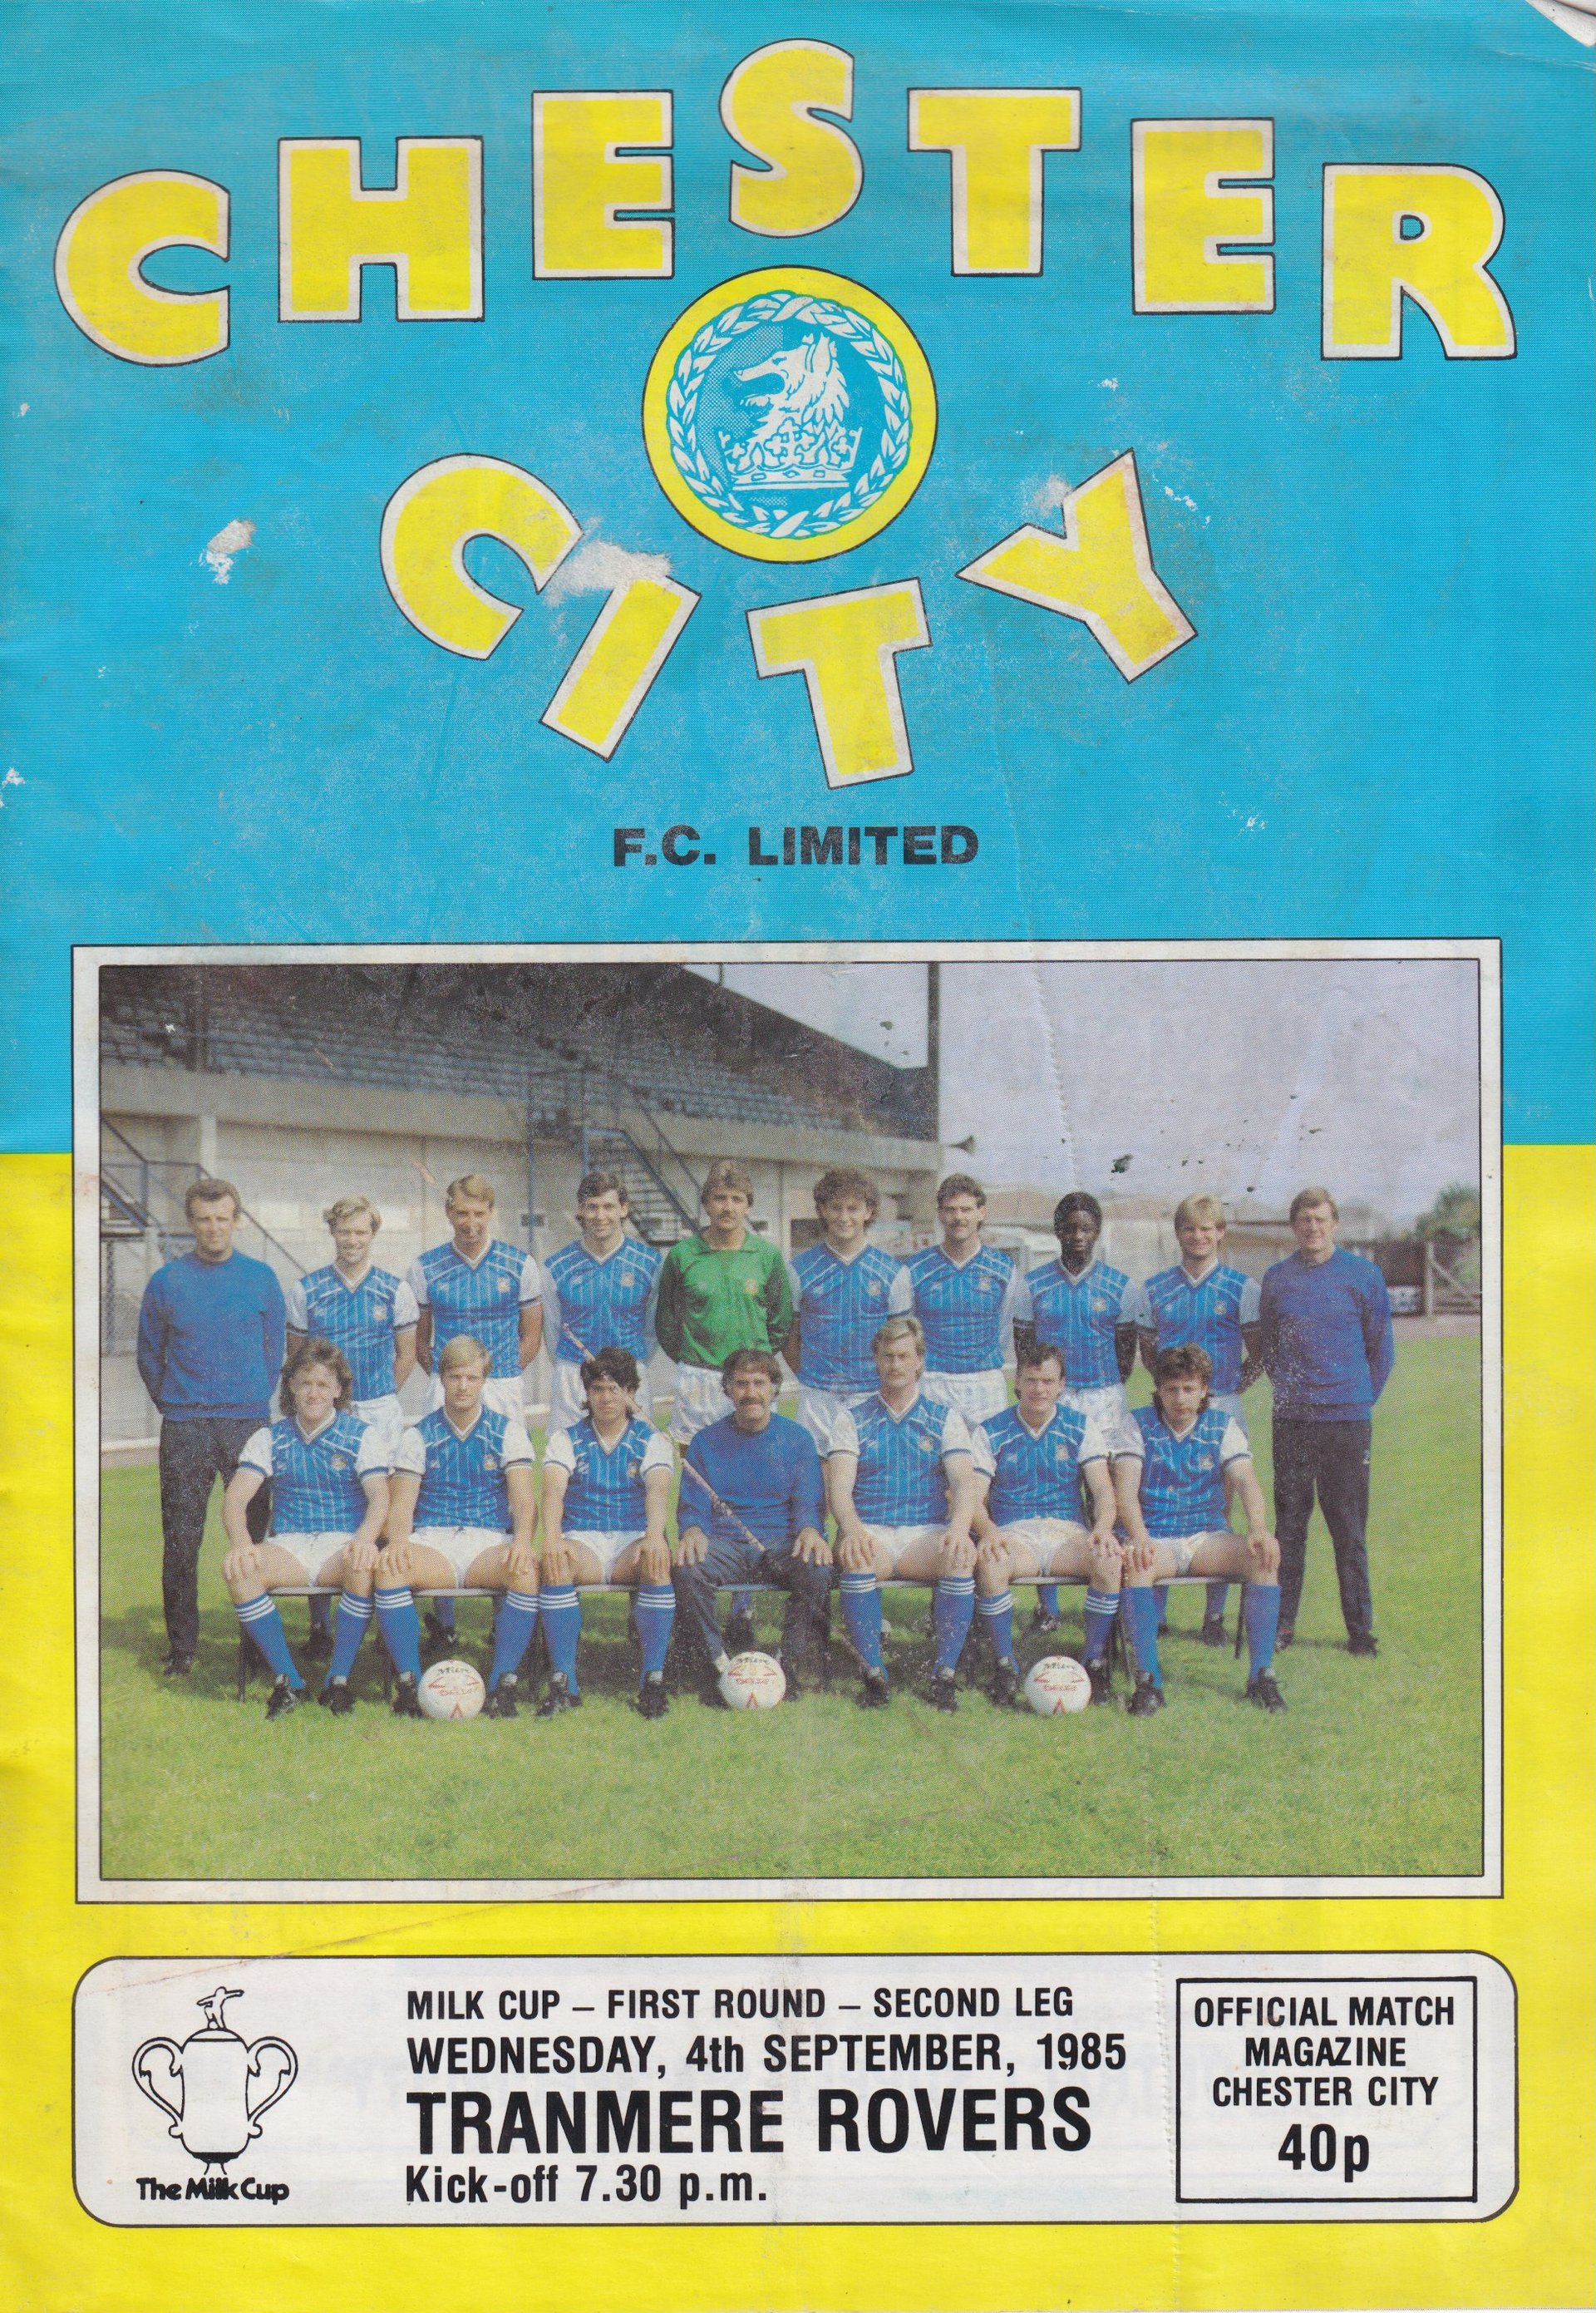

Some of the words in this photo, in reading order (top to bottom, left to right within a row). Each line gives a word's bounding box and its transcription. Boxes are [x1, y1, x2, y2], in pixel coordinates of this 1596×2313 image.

[54, 37, 1517, 367] CHESTER
[380, 449, 1197, 789] CITY
[614, 826, 716, 866] F.C.
[749, 826, 978, 866] LIMITED
[408, 1991, 484, 2019] MILK
[500, 1990, 559, 2020] CUP
[608, 1990, 699, 2019] FIRST
[715, 1989, 825, 2018] ROUND
[874, 1988, 999, 2017] SECOND
[1017, 1987, 1072, 2016] LEG
[1195, 1997, 1337, 2027] OFFICIAL
[1350, 1996, 1453, 2026] MATCH
[407, 2036, 665, 2079] WEDNESDAY,
[687, 2036, 743, 2073] 4th
[764, 2034, 1014, 2076] SEPTEMBER,
[1037, 2033, 1126, 2070] 1985
[1246, 2037, 1406, 2067] MAGAZINE
[1214, 2077, 1352, 2107] CHESTER
[1369, 2077, 1438, 2106] CITY
[407, 2090, 783, 2154] TRANMERE
[819, 2087, 1091, 2153] ROVERS
[1278, 2124, 1369, 2182] 40p
[136, 2177, 181, 2200] The
[185, 2177, 239, 2200] Milk
[240, 2177, 290, 2205] Cup
[406, 2165, 558, 2203] Kick-off
[577, 2165, 660, 2202] 7.30
[681, 2172, 766, 2210] p.m.
